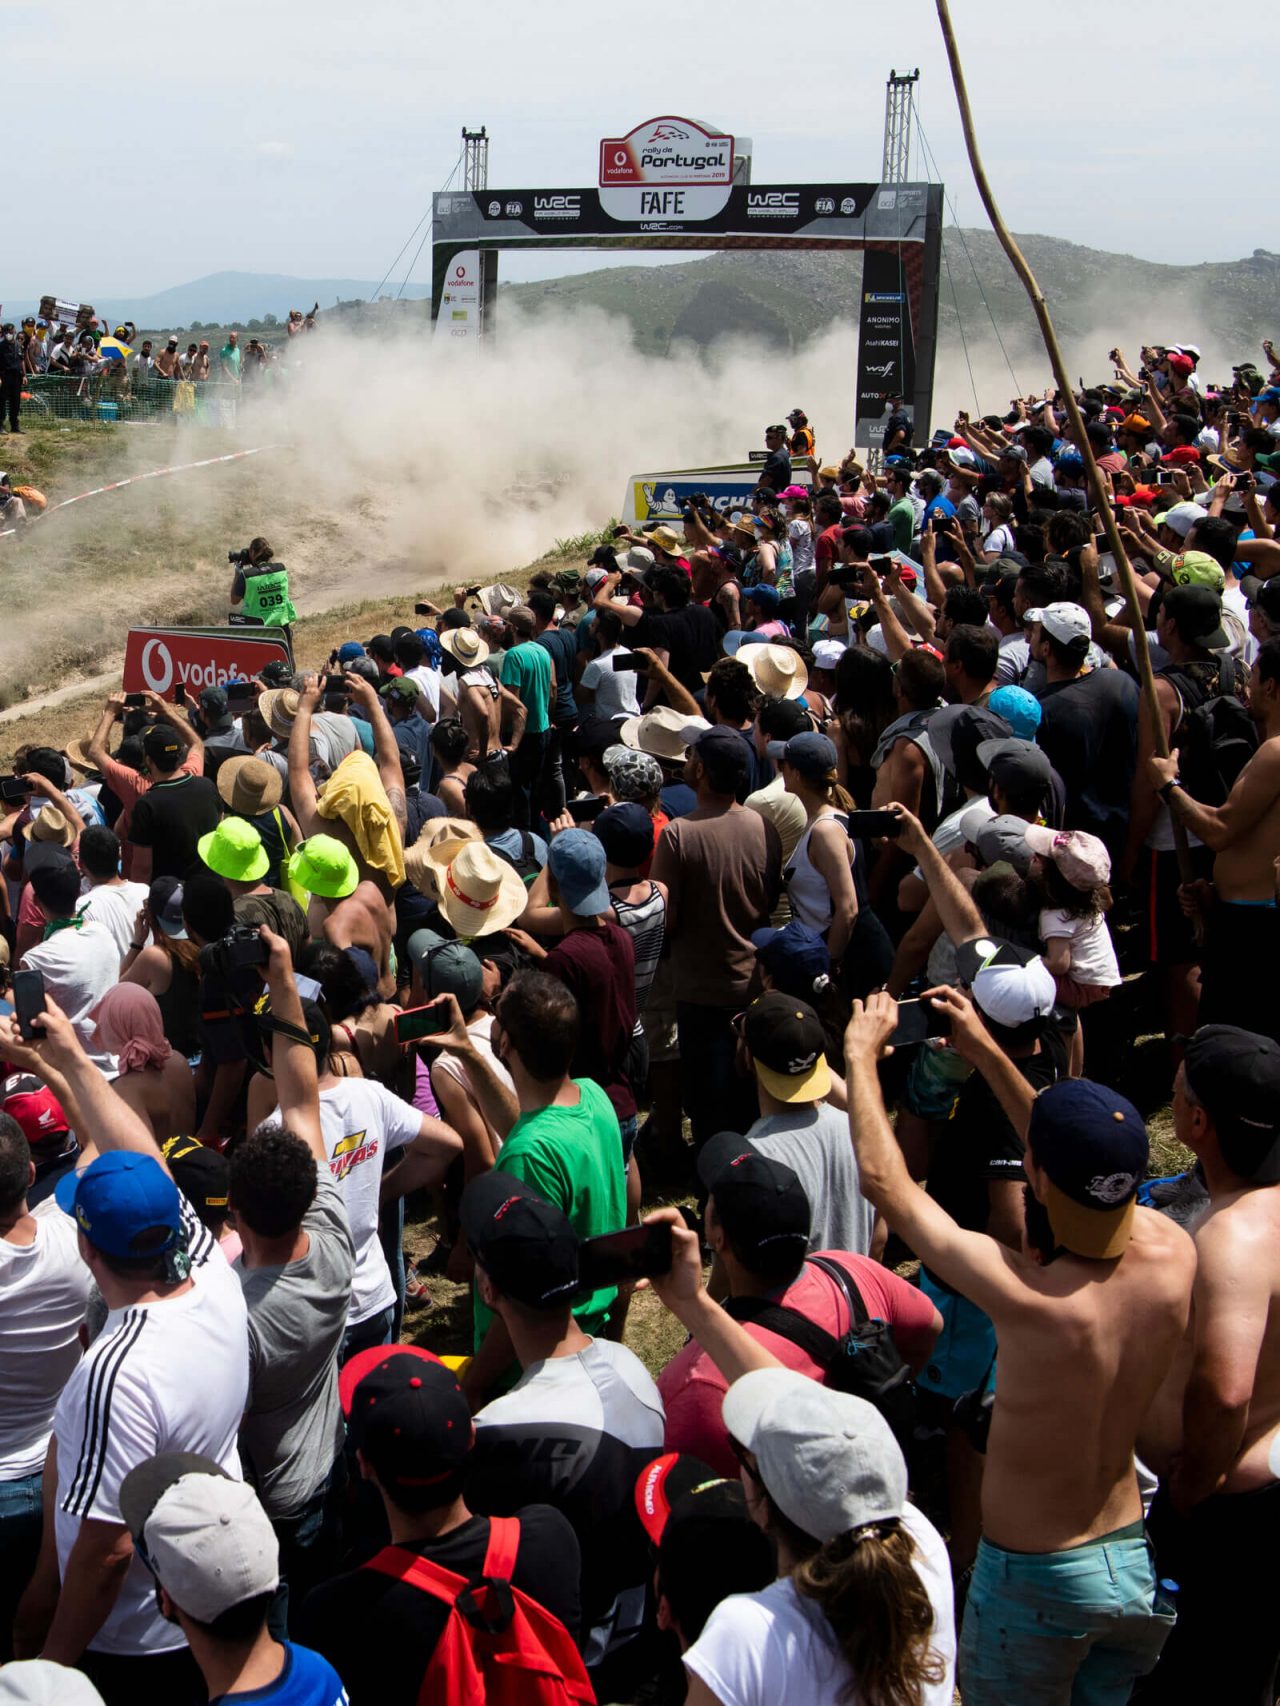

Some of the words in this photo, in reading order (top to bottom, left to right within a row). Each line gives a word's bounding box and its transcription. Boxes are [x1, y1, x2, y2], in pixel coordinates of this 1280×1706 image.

[642, 147, 661, 155] rally
[641, 153, 726, 170] Portugal
[534, 195, 581, 209] WRC
[640, 191, 685, 215] FAFE
[748, 192, 801, 206] WRC
[816, 201, 833, 211] FIA
[506, 204, 522, 214] FIA
[259, 594, 284, 608] 039
